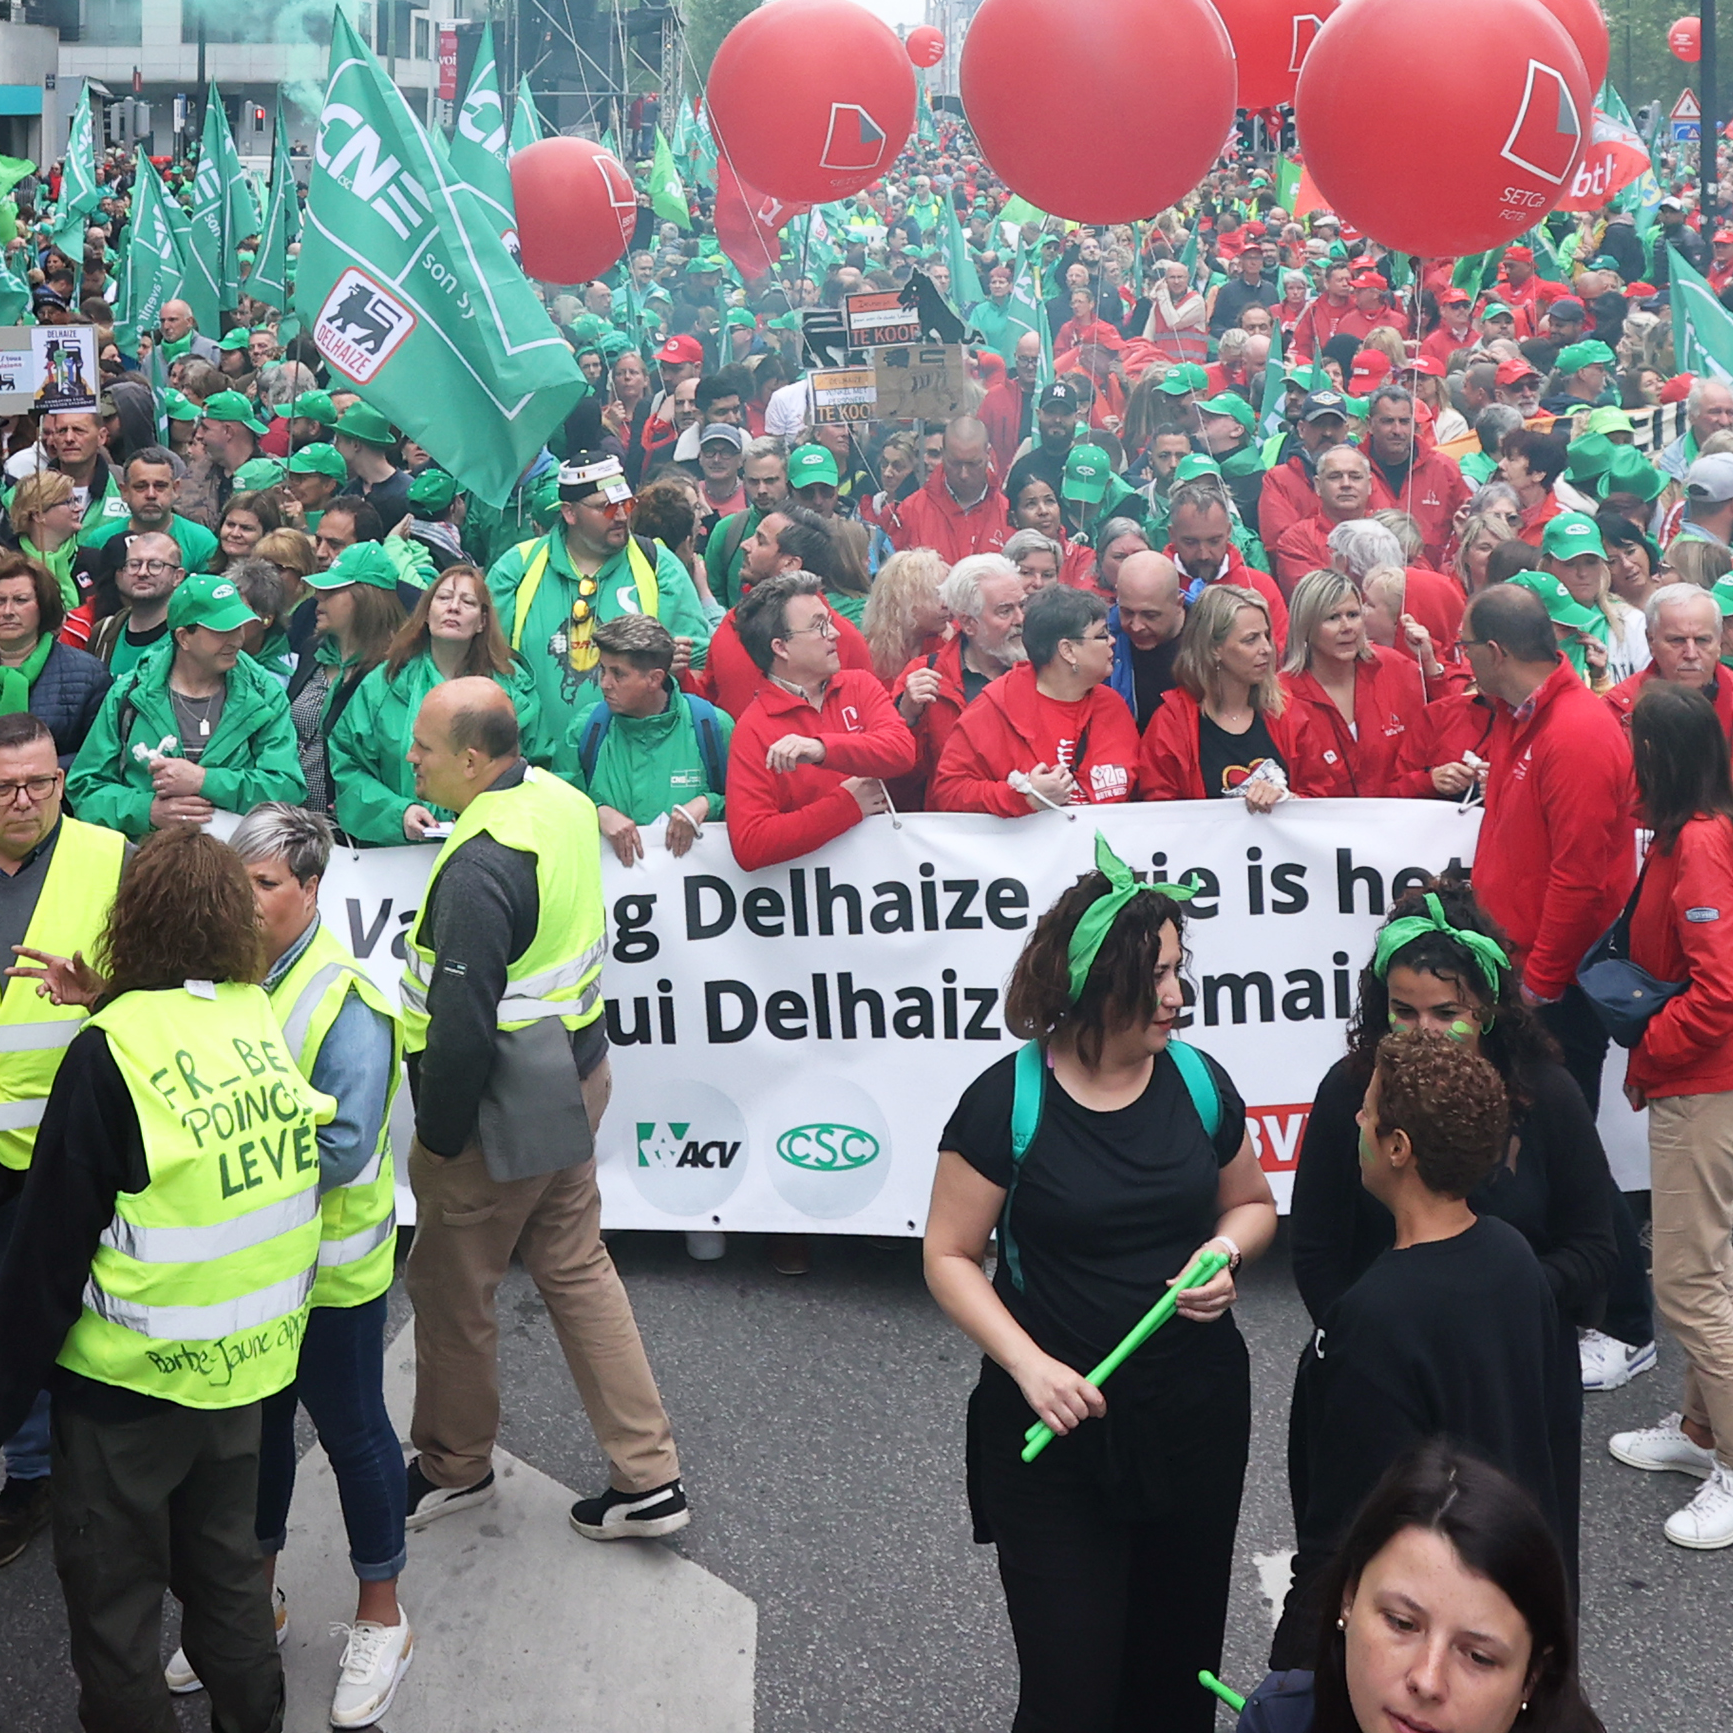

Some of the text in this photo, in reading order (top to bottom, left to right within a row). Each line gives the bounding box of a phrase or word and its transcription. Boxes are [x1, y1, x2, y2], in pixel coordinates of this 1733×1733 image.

[315, 103, 432, 242] CNE
[1499, 187, 1546, 207] SETCa
[422, 252, 459, 296] son
[47, 330, 77, 339] DELHAIZE
[317, 324, 372, 375] DELHAIZE
[852, 325, 921, 346] TE KOOP
[817, 404, 870, 421] TE KOO
[685, 862, 1046, 941] Delhaize
[1246, 846, 1309, 916] is
[706, 969, 1024, 1044] Delhaiz
[676, 1140, 740, 1168] ACV
[786, 1127, 874, 1165] CSC
